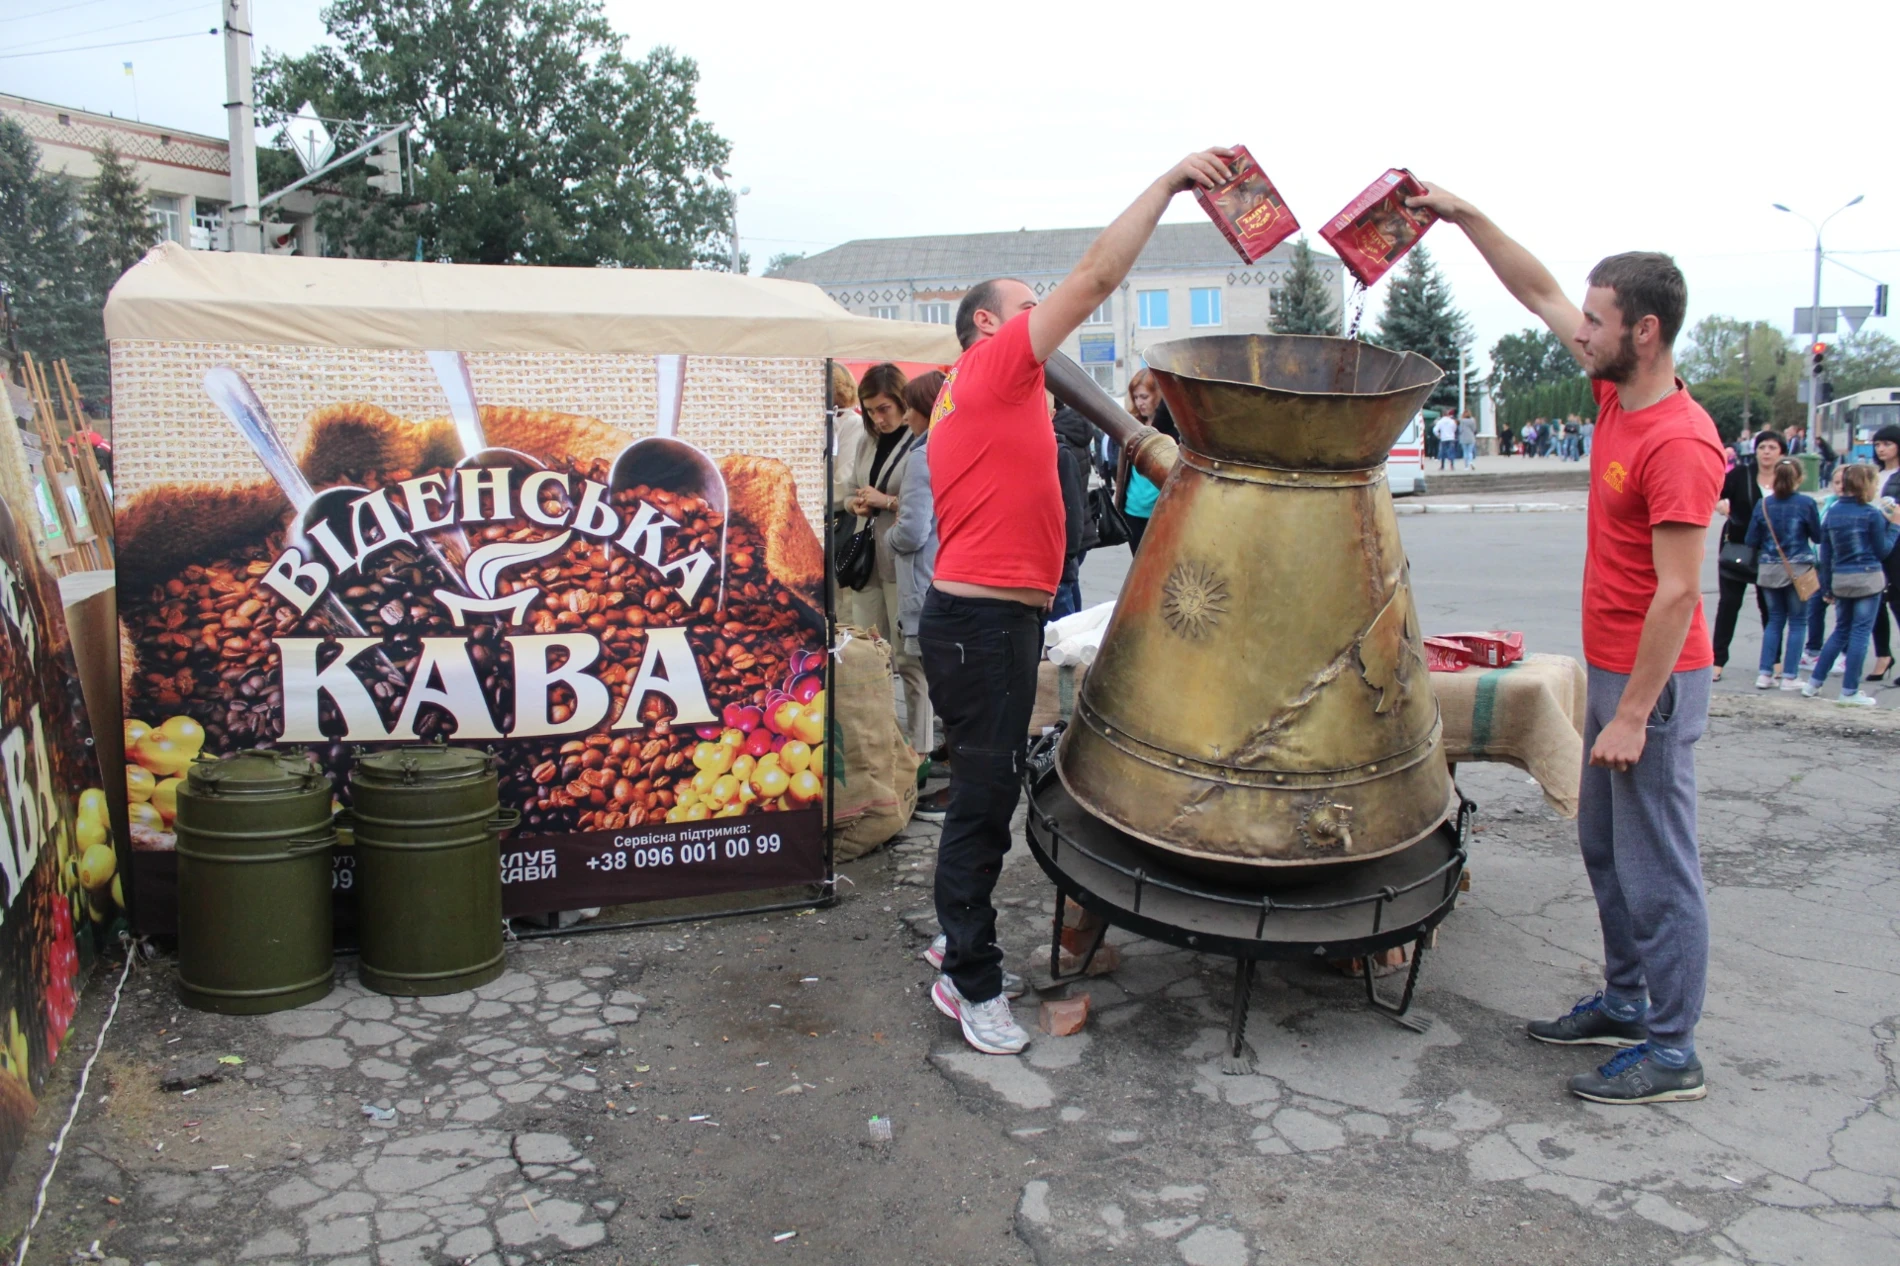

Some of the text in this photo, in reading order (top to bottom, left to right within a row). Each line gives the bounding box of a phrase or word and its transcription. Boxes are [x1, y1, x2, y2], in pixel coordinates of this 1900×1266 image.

[261, 467, 715, 615] ВІДЕНСЬКА
[272, 628, 719, 742] КАВА
[586, 833, 781, 872] +38 096 001 00 99
[613, 823, 752, 849] Сервісна підтримка:
